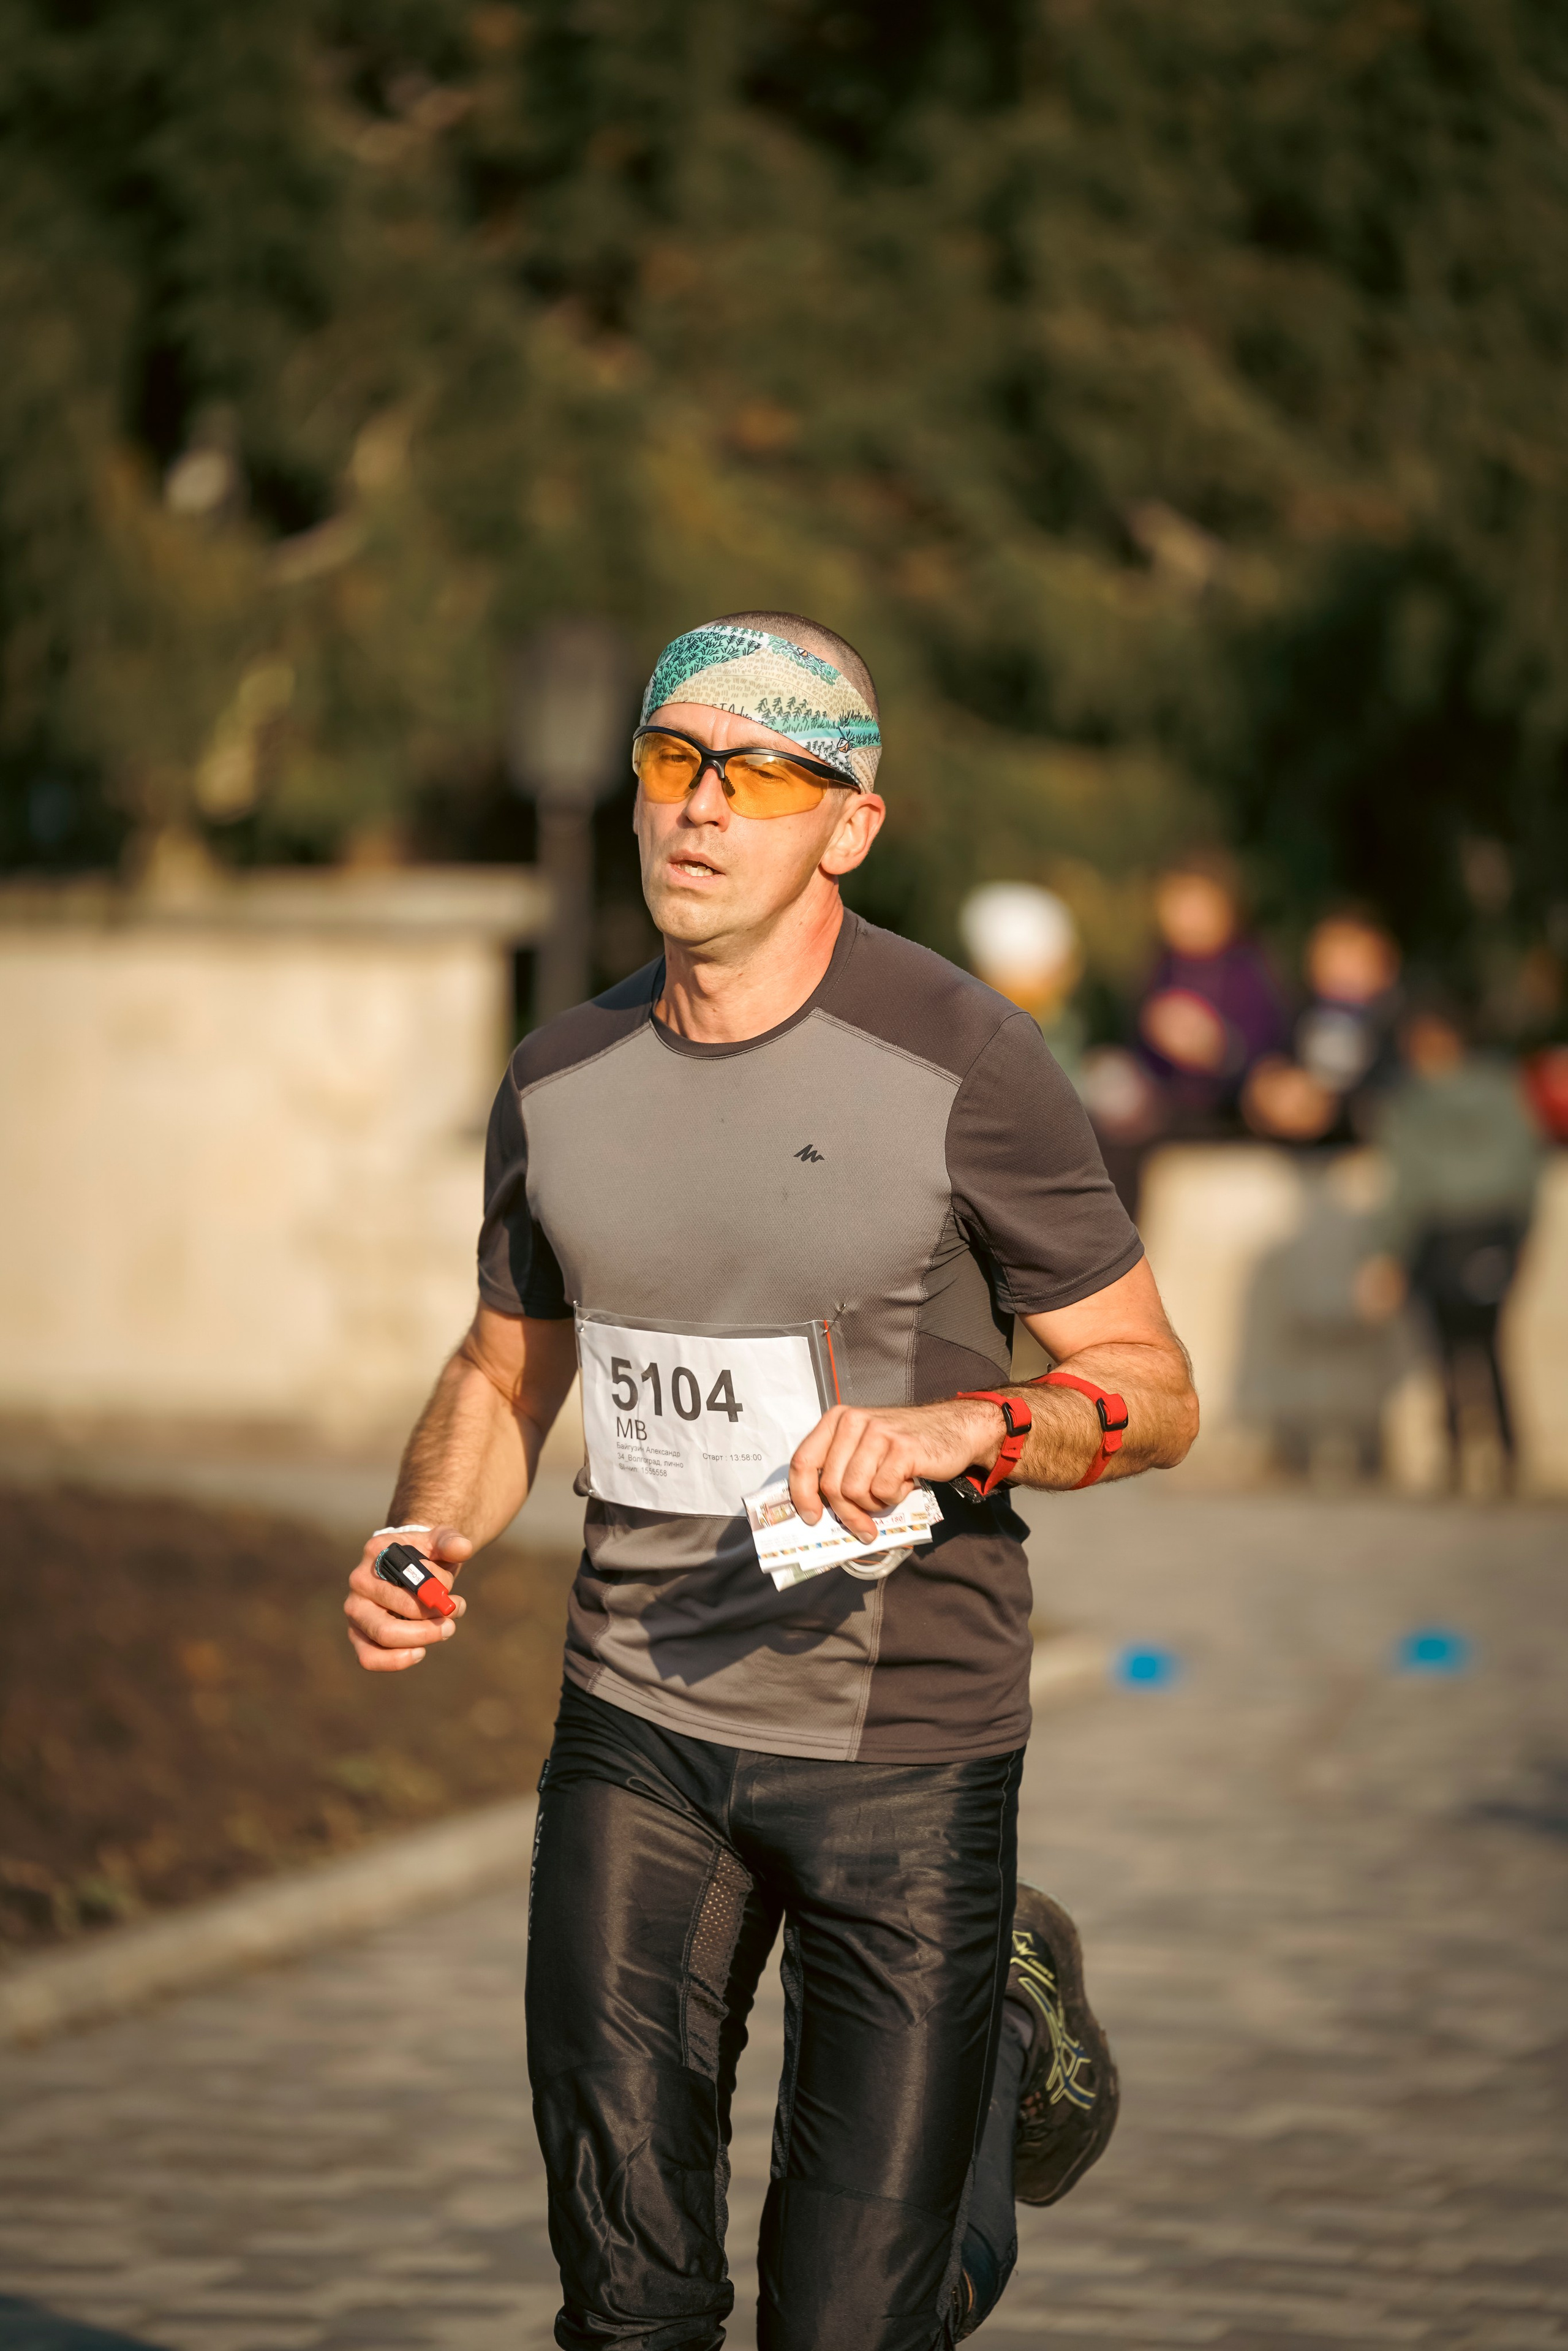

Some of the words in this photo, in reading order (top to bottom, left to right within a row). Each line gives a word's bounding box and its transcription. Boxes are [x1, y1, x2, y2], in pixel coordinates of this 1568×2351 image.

[611, 1356, 743, 1422] 5104
[646, 1446, 680, 1457] Александр
[703, 1452, 723, 1462] Старт
[729, 1453, 762, 1462] 13:58:00
[641, 1467, 668, 1477] 1555558
